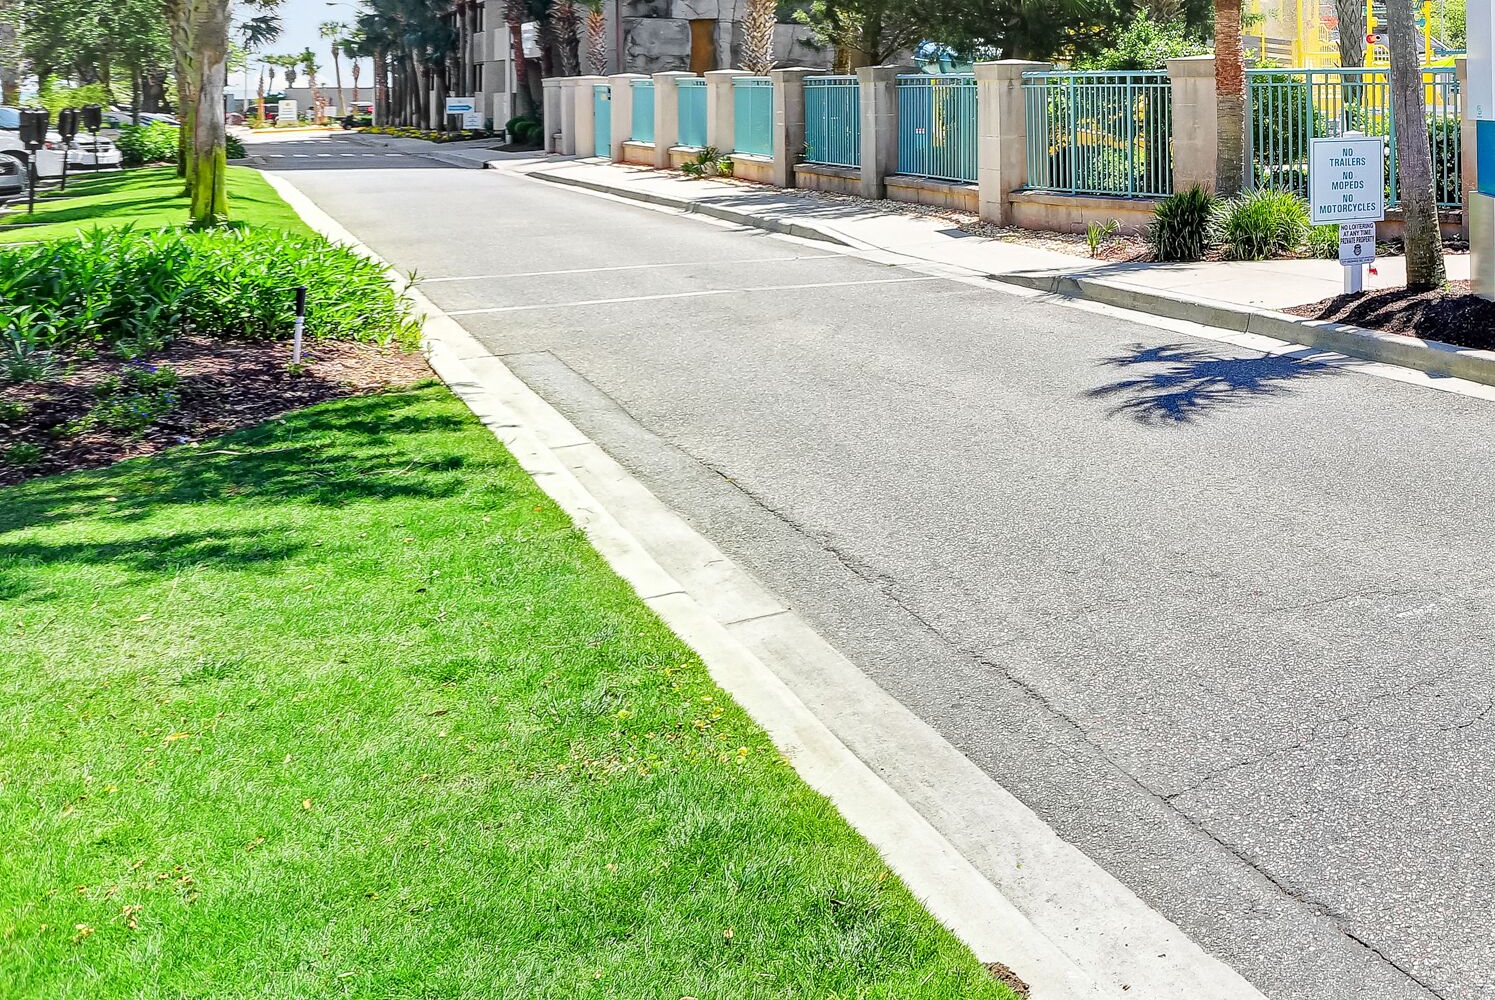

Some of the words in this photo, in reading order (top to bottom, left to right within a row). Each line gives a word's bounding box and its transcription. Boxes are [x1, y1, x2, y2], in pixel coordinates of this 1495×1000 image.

[1342, 148, 1353, 157] NO
[1329, 158, 1366, 167] TRAILERS
[1342, 171, 1353, 180] NO
[1331, 180, 1364, 190] MOPEDS
[1342, 194, 1353, 203] NO
[1319, 202, 1376, 214] MOTORCYCLES
[1349, 222, 1374, 230] LOITERING
